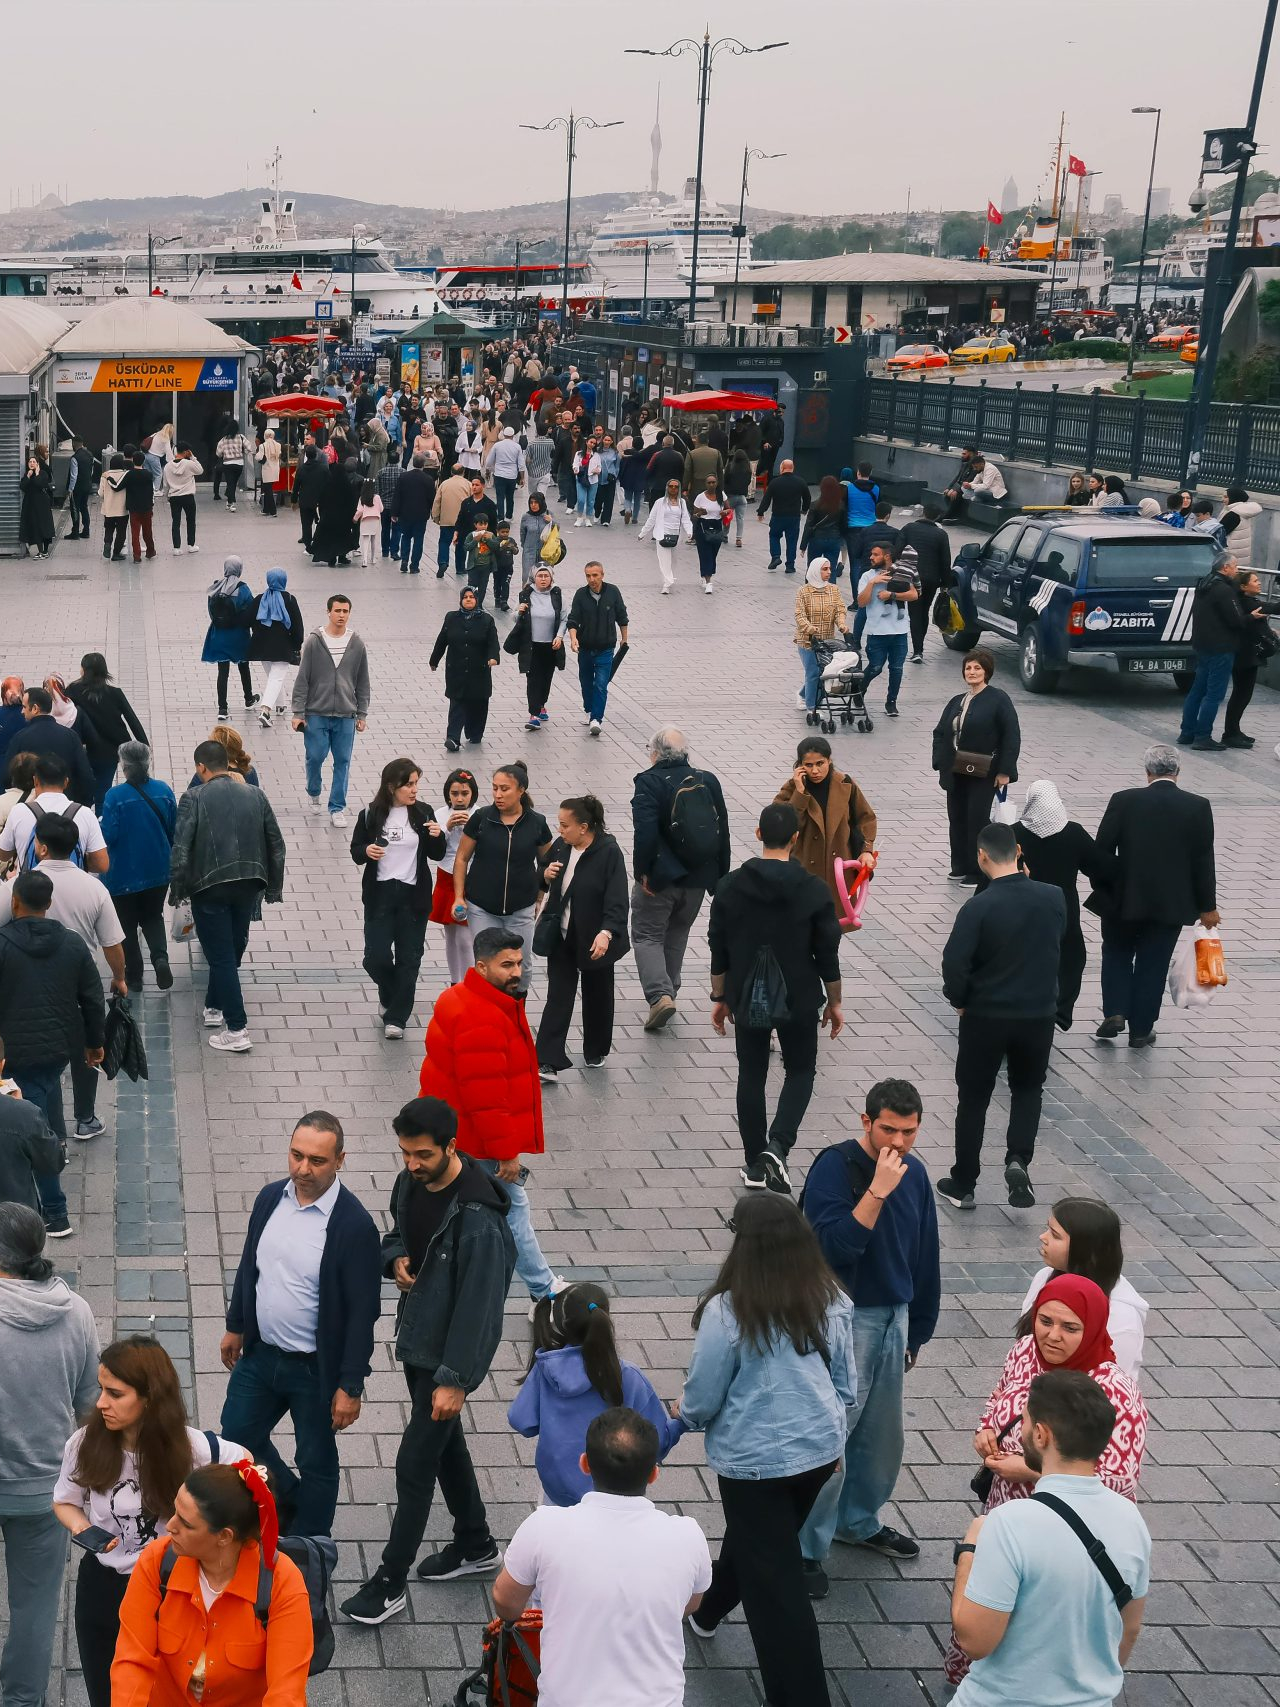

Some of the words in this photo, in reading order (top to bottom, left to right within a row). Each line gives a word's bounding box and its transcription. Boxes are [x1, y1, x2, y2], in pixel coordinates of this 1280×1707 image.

[116, 362, 175, 375] ÜSKÜDAR
[108, 378, 143, 388] HATTI
[155, 378, 182, 388] LINE
[1112, 618, 1156, 628] ZABITA
[1133, 661, 1144, 670] 34
